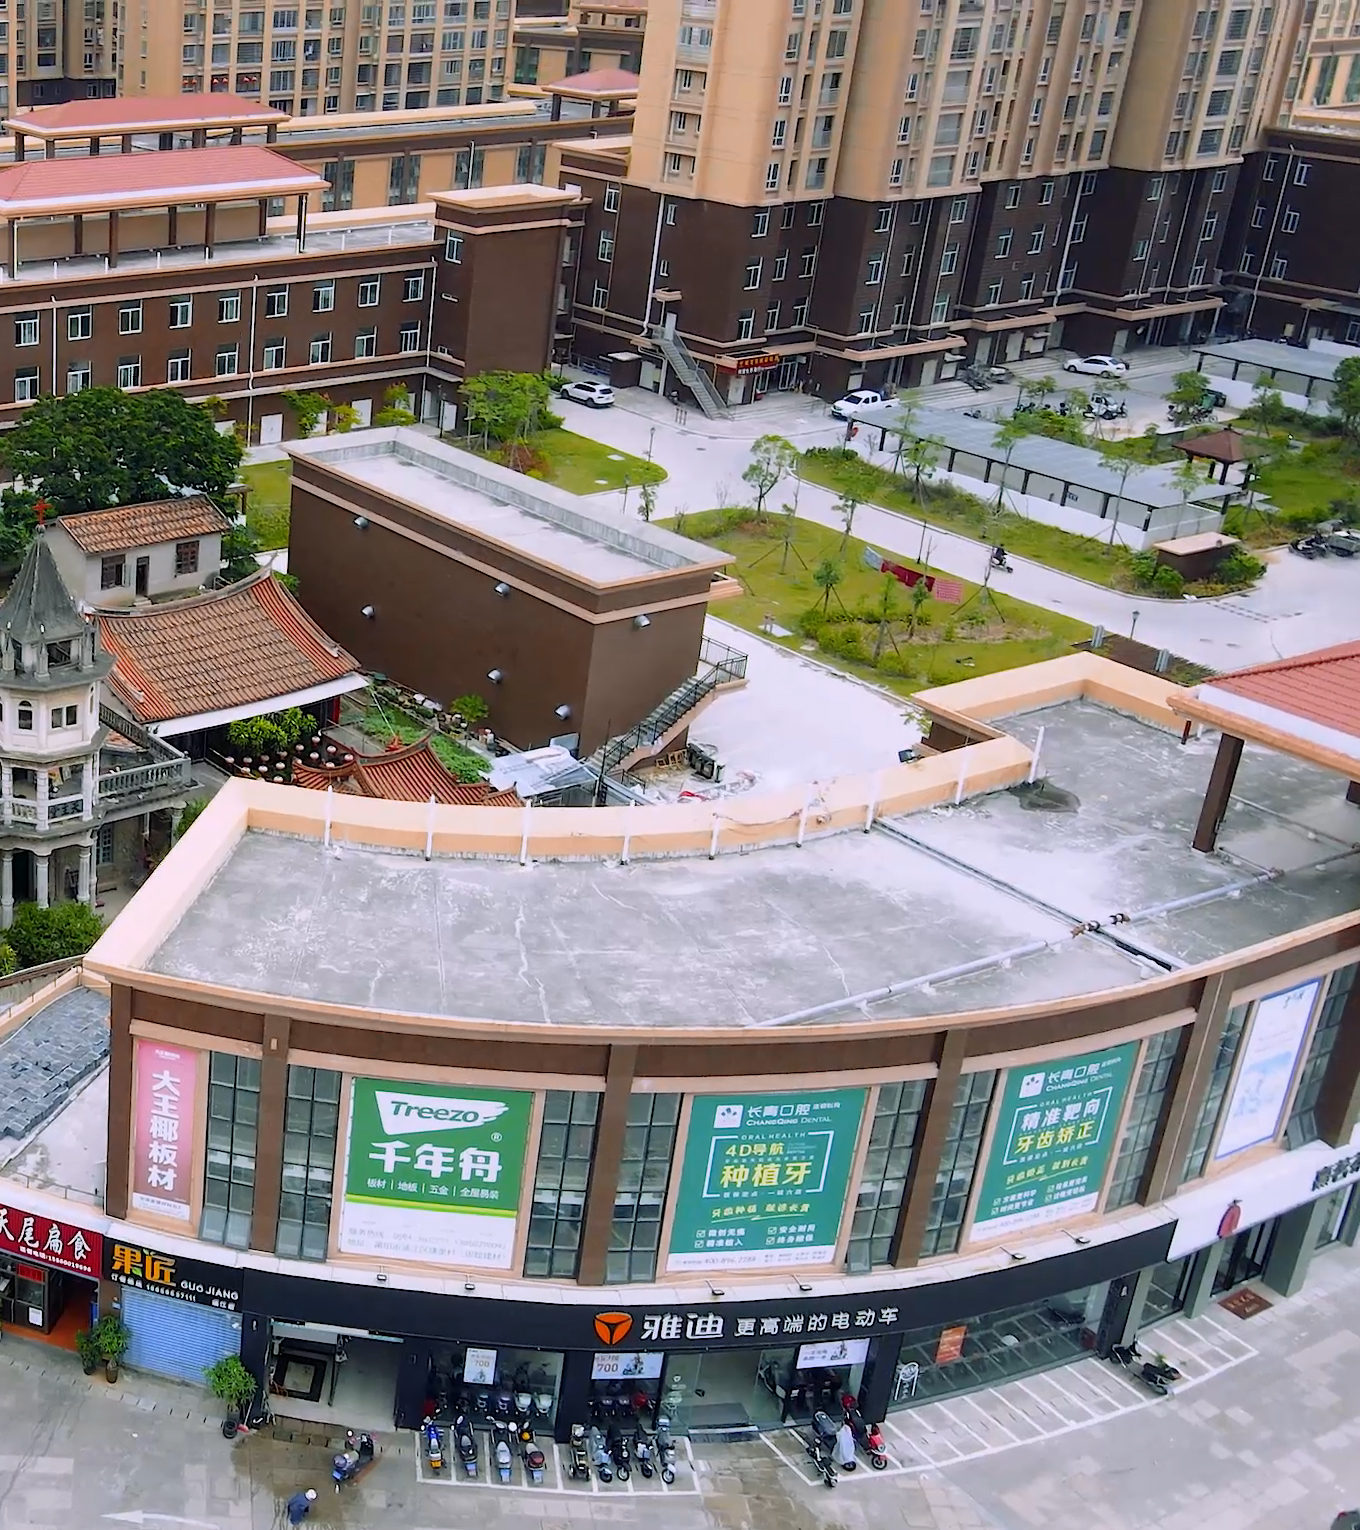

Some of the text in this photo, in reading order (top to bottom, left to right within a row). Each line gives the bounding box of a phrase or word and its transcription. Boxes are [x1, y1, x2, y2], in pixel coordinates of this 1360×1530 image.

[1047, 1062, 1101, 1084] 长青口腔
[391, 1101, 480, 1123] Treezo
[746, 1115, 832, 1127] CHANGQING DENTAL
[747, 1103, 811, 1118] 长青口腔
[1020, 1098, 1101, 1131] 精准靶向
[147, 1070, 181, 1191] 大王椰板材
[1014, 1120, 1095, 1154] 牙齿矫正
[725, 1143, 785, 1157] 4D导航
[368, 1140, 503, 1183] 千年舟
[367, 1177, 387, 1189] 板材
[398, 1181, 418, 1193] 地板
[429, 1184, 449, 1195] 五金
[720, 1162, 812, 1189] 种植牙
[111, 1244, 176, 1287] 果匠
[180, 1279, 239, 1301] GUO JIANG
[640, 1306, 900, 1341] 雅迪 更高端的电动车
[597, 1363, 619, 1373] 700
